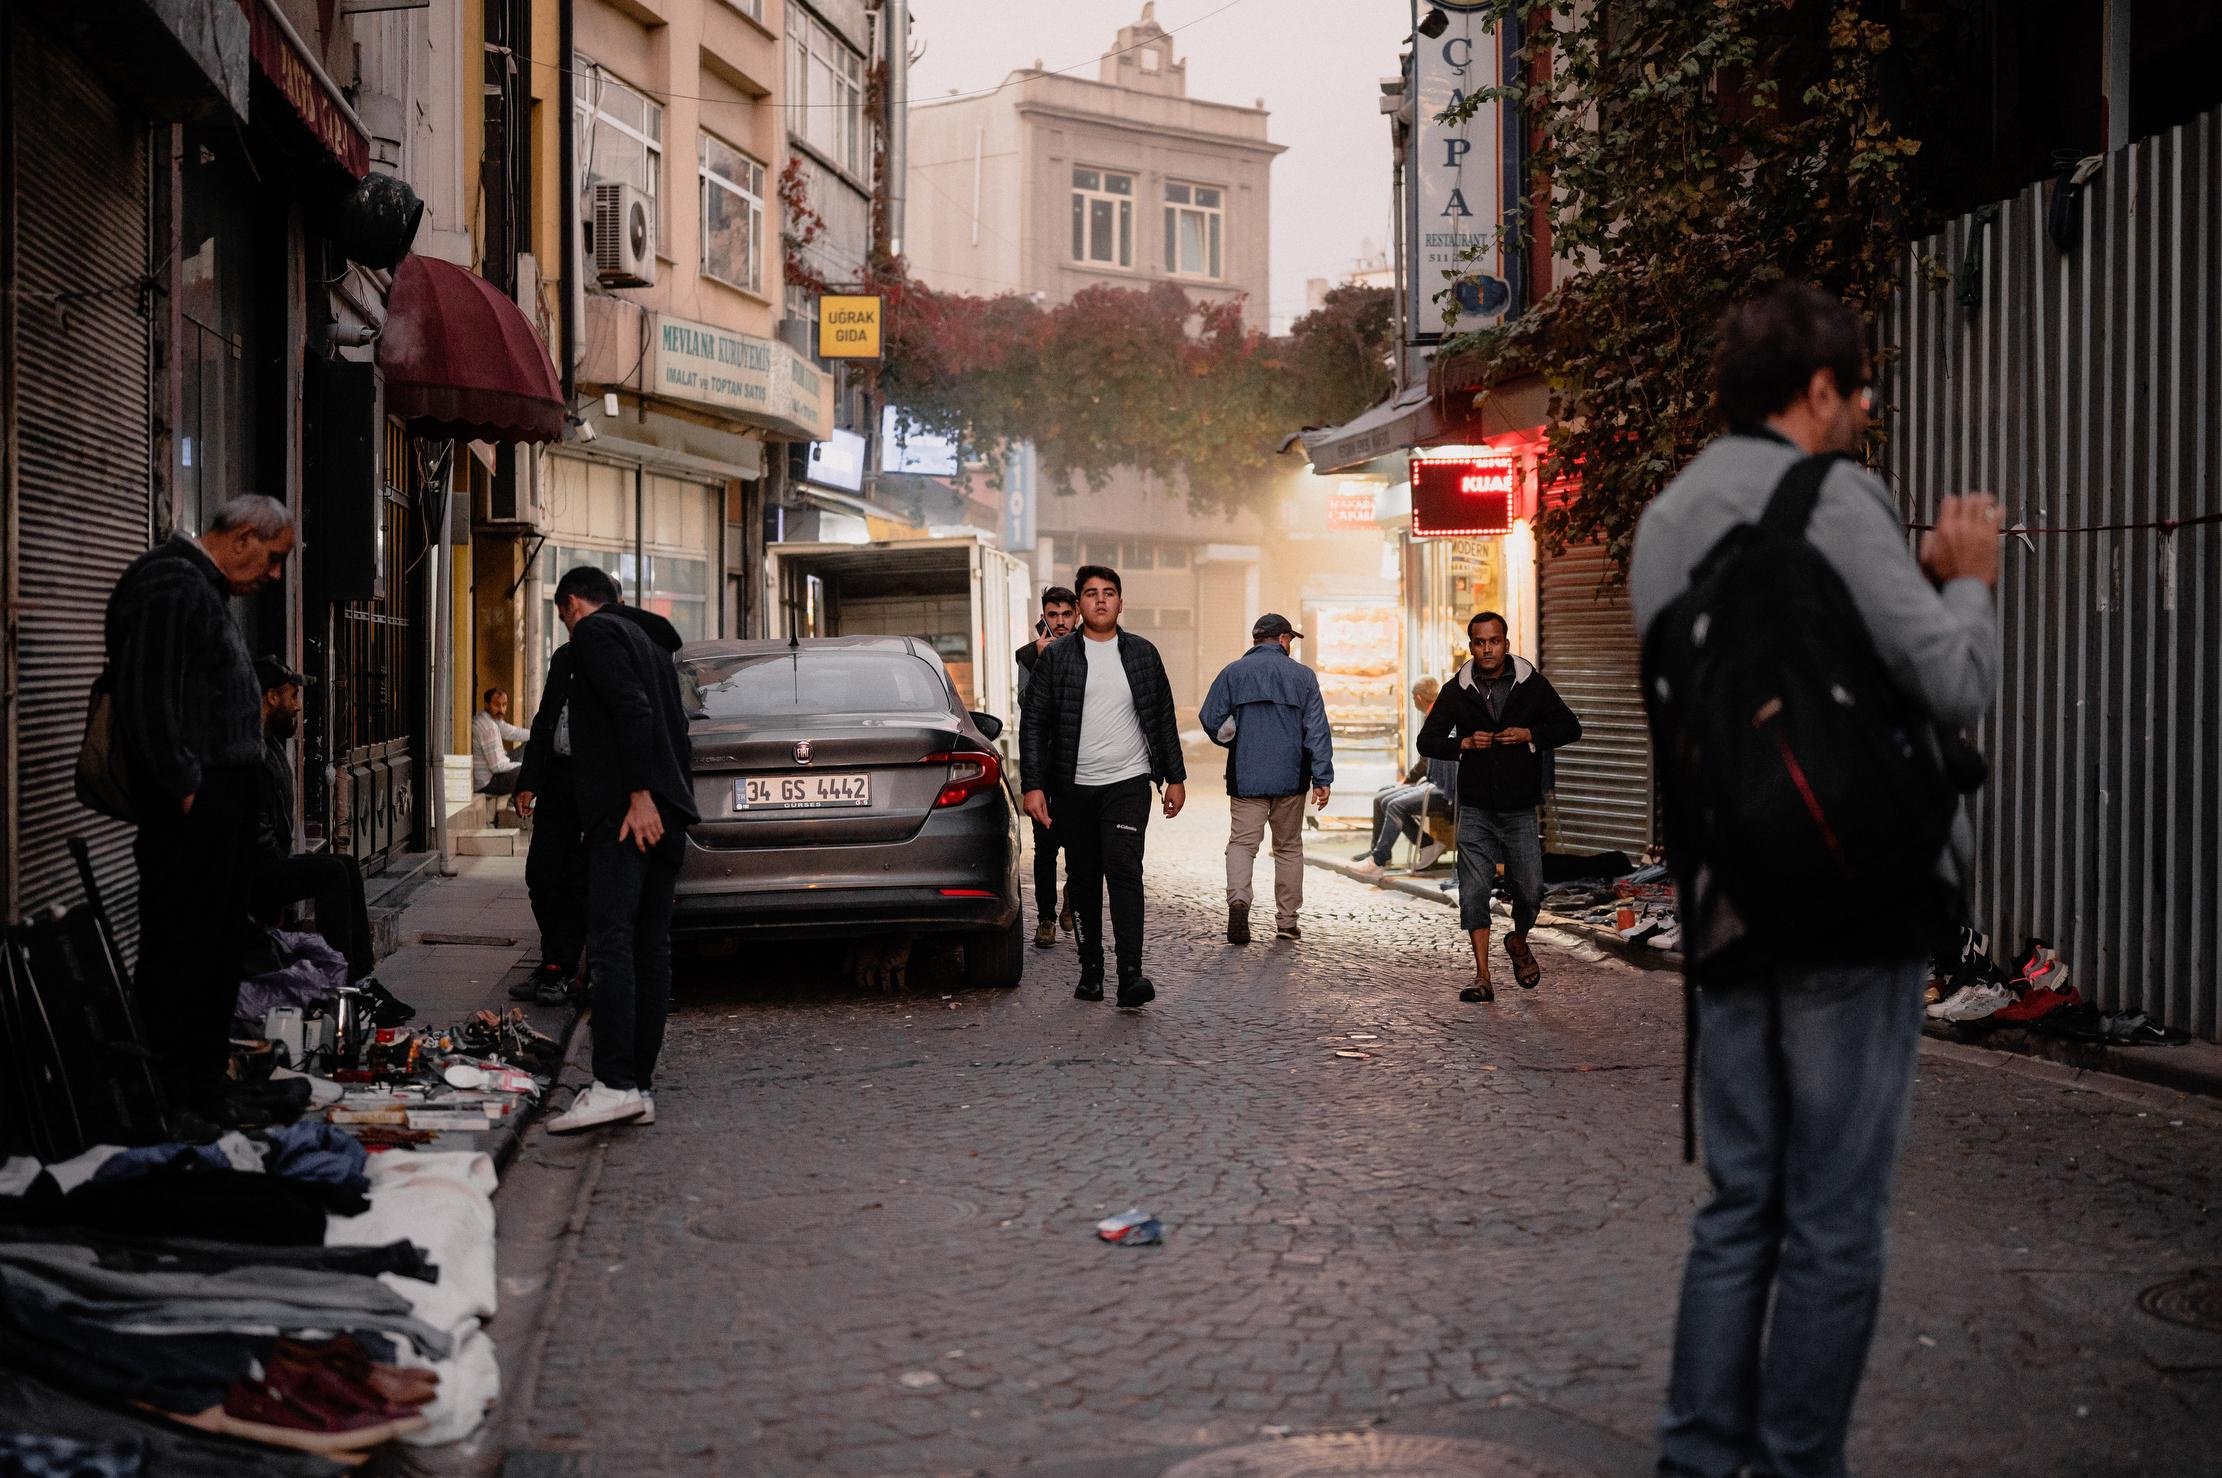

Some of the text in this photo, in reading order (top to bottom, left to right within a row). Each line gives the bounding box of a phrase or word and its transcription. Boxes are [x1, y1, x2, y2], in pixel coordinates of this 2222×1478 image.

[1442, 37, 1473, 217] ÇAPA
[1425, 233, 1487, 247] RESTAURANT
[828, 307, 875, 324] UĞRAK
[662, 324, 715, 360] MEVLANA
[835, 328, 868, 342] GIDA
[666, 363, 698, 387] İMALAT
[711, 376, 743, 396] TOPTAN
[744, 382, 767, 404] SATIŞ
[797, 747, 810, 758] FIAT
[737, 793, 746, 801] TR
[747, 777, 866, 801] 34 GS 4442
